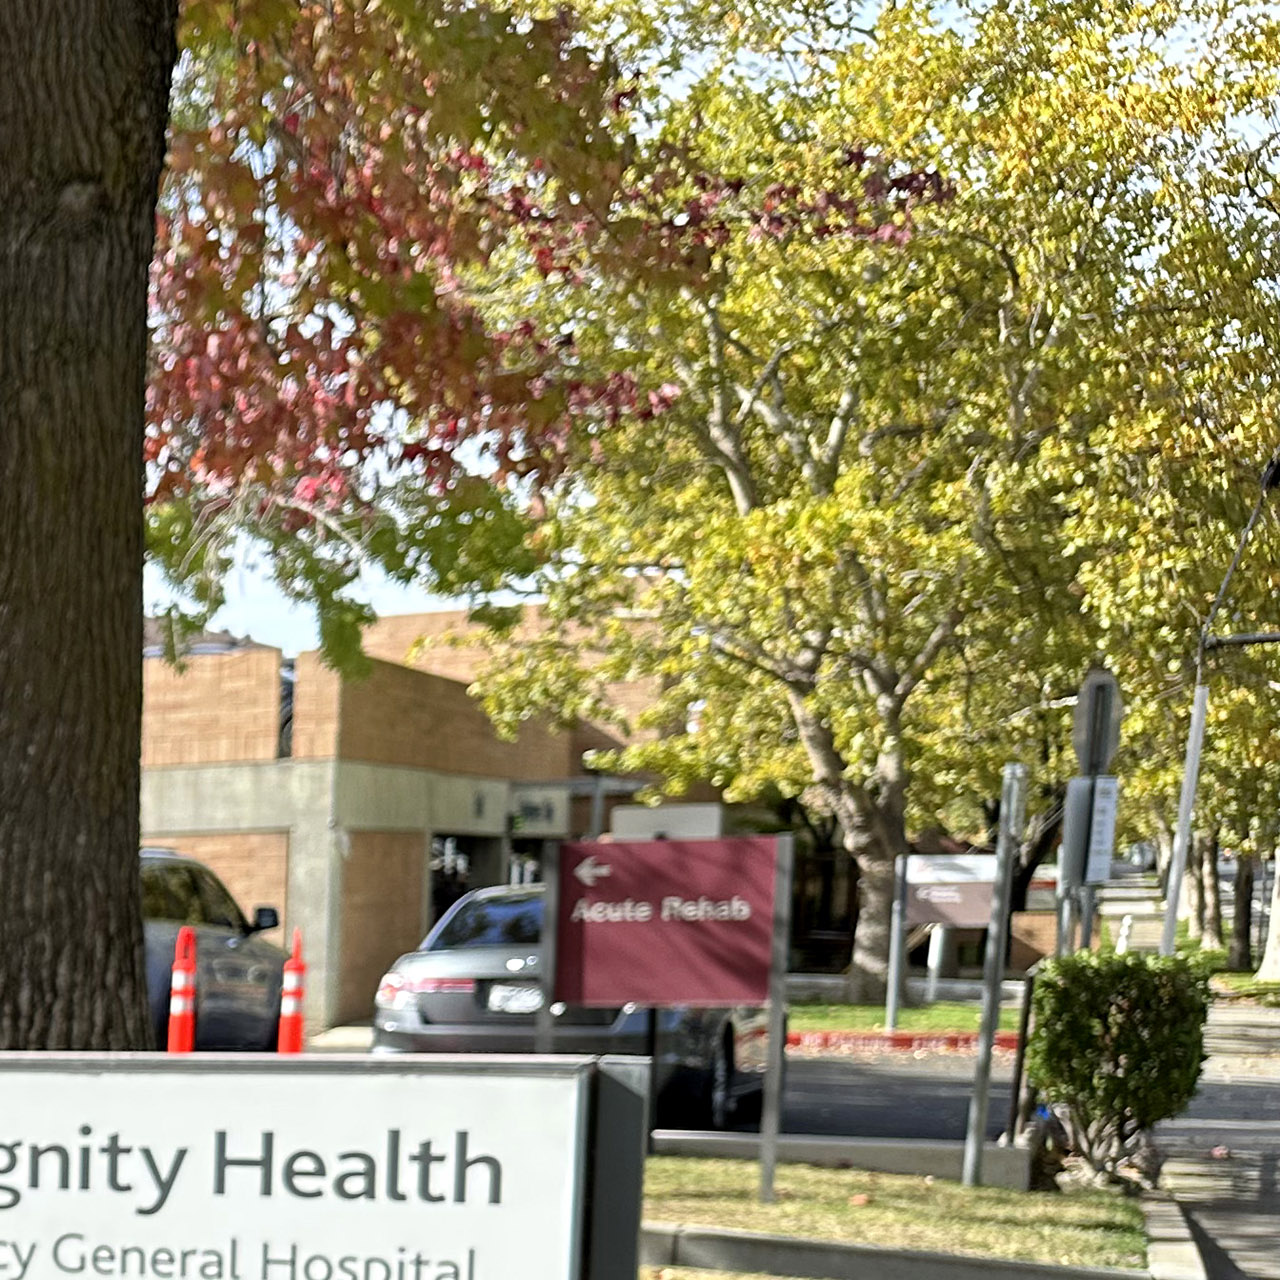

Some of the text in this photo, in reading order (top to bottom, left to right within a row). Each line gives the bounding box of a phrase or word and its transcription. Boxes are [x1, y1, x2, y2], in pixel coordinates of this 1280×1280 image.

[570, 894, 751, 923] Acute Rehab
[213, 1129, 503, 1206] Health
[52, 1233, 241, 1280] General
